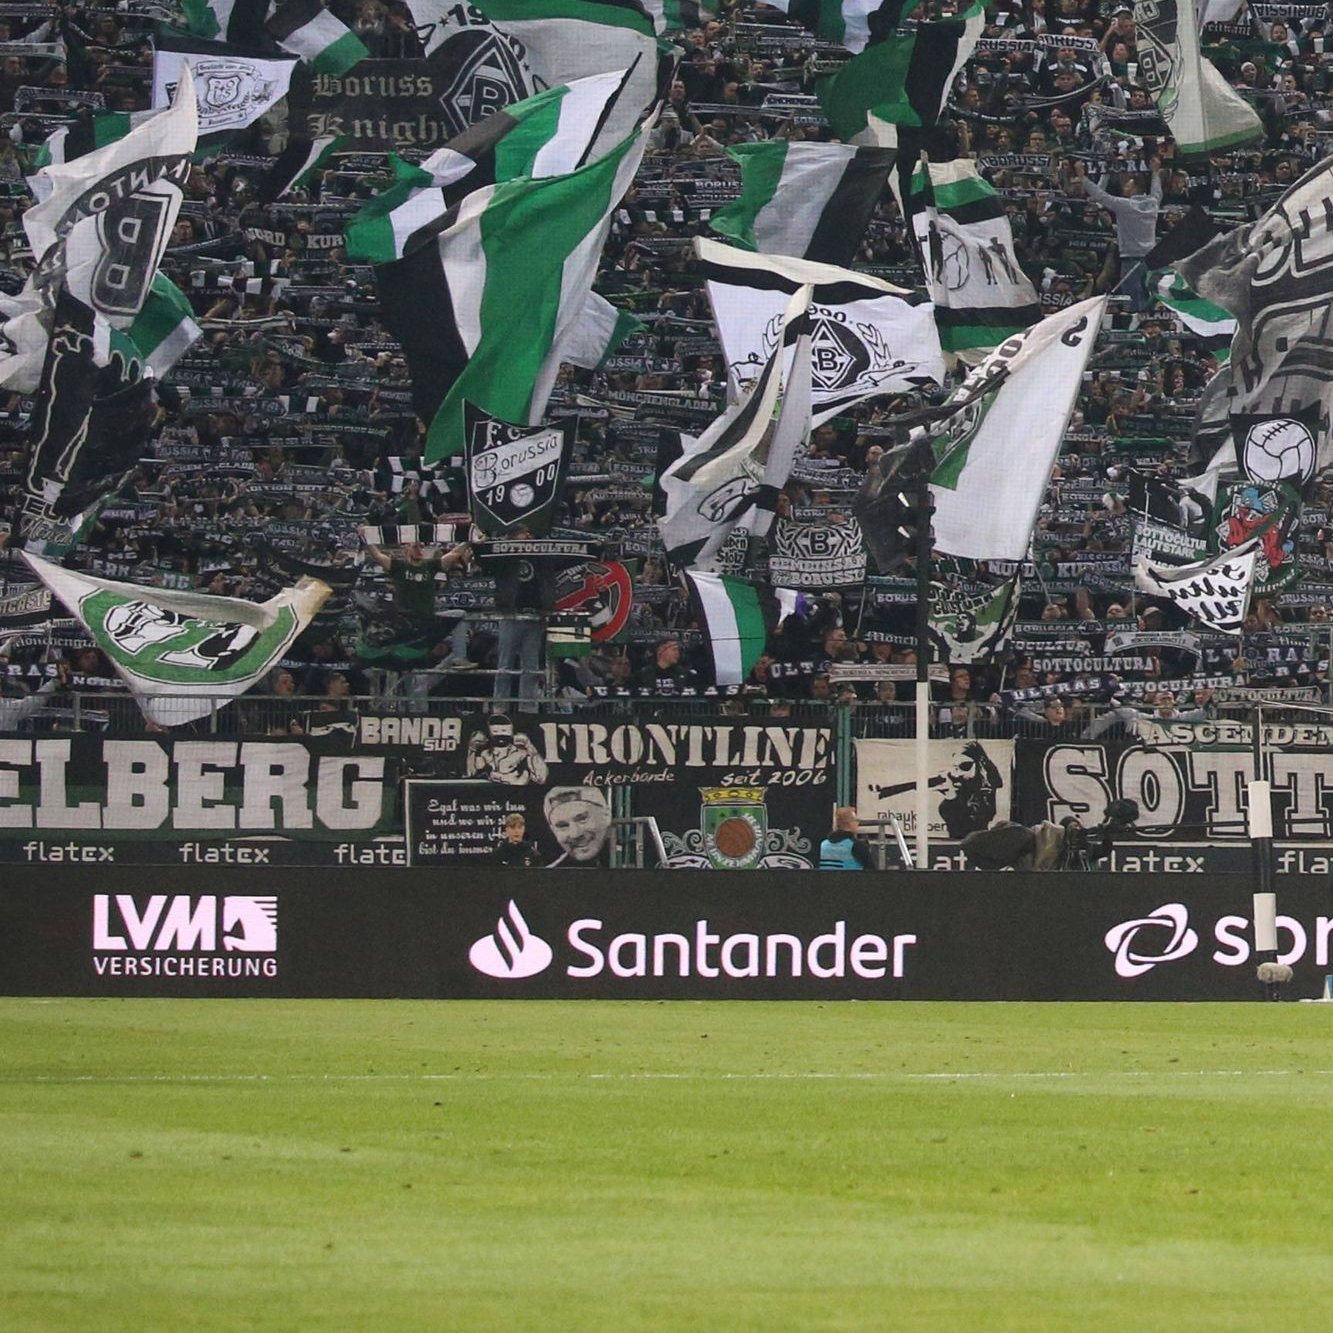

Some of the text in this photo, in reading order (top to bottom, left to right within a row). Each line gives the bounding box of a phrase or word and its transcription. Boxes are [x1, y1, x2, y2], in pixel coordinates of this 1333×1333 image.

[312, 73, 434, 102] Boruss
[307, 114, 450, 146] Knigh
[608, 390, 718, 411] MÖNCHENGLADBA
[484, 490, 505, 506] 19
[492, 541, 589, 554] SOTTOCULTURA
[1135, 527, 1207, 551] SOTTOCULTUR
[1032, 657, 1154, 674] SOTTOCULTURA
[1011, 676, 1101, 700] ULTRAS
[1118, 673, 1246, 695] TTOCULTURA
[360, 715, 461, 745] BANDA
[539, 721, 833, 770] FRONTLINE
[719, 770, 761, 786] seit
[766, 767, 827, 786] 2006
[427, 797, 456, 815] Egal
[457, 800, 481, 812] was
[483, 798, 504, 812] wir
[877, 809, 918, 824] rabauk
[432, 813, 453, 826] und
[24, 842, 115, 862] flatex
[179, 843, 270, 863] flatex
[333, 844, 406, 863] flate
[92, 894, 217, 951] LVM
[566, 916, 917, 980] Santander
[92, 956, 278, 978] VERSICHERUNG
